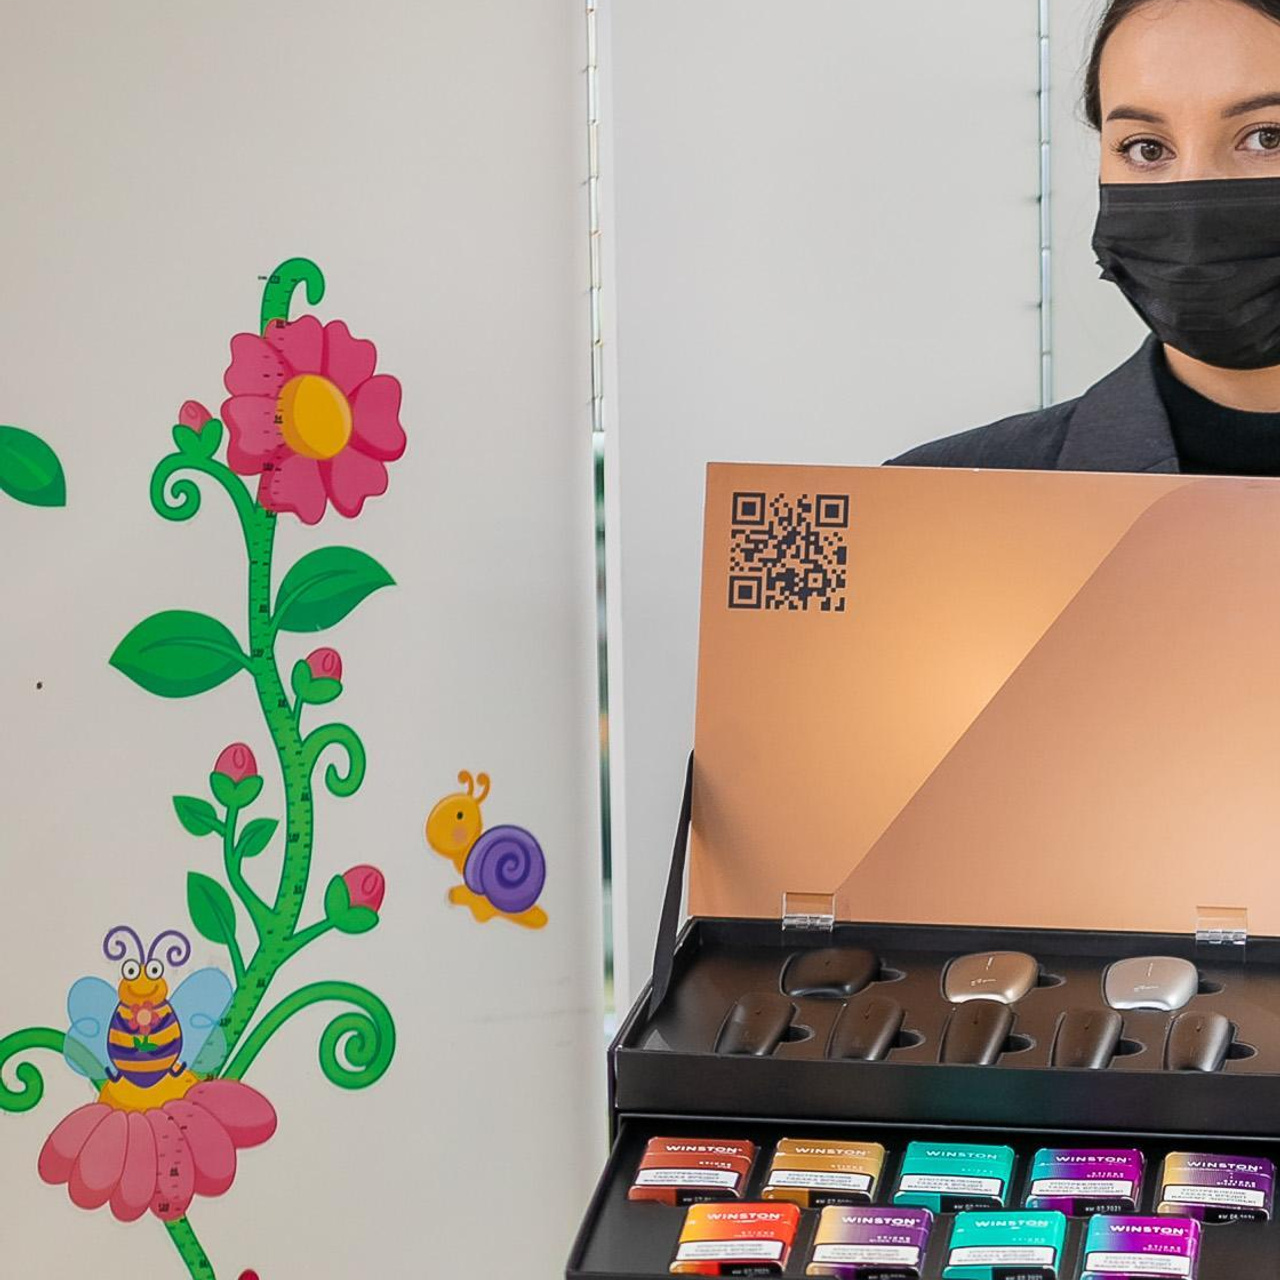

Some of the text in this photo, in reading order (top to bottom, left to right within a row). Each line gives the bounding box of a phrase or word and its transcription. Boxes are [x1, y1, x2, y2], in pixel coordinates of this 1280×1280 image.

[665, 1145, 737, 1154] WINSTON
[795, 1147, 867, 1156] WINSTON
[926, 1150, 998, 1160] WINSTON
[1056, 1156, 1127, 1164] WINSTON
[1187, 1161, 1260, 1172] WINSTON
[706, 1212, 781, 1220] WINSTON
[841, 1216, 916, 1226] WINSTON
[974, 1220, 1049, 1228] WINSTON
[1110, 1225, 1184, 1235] WINSTON
